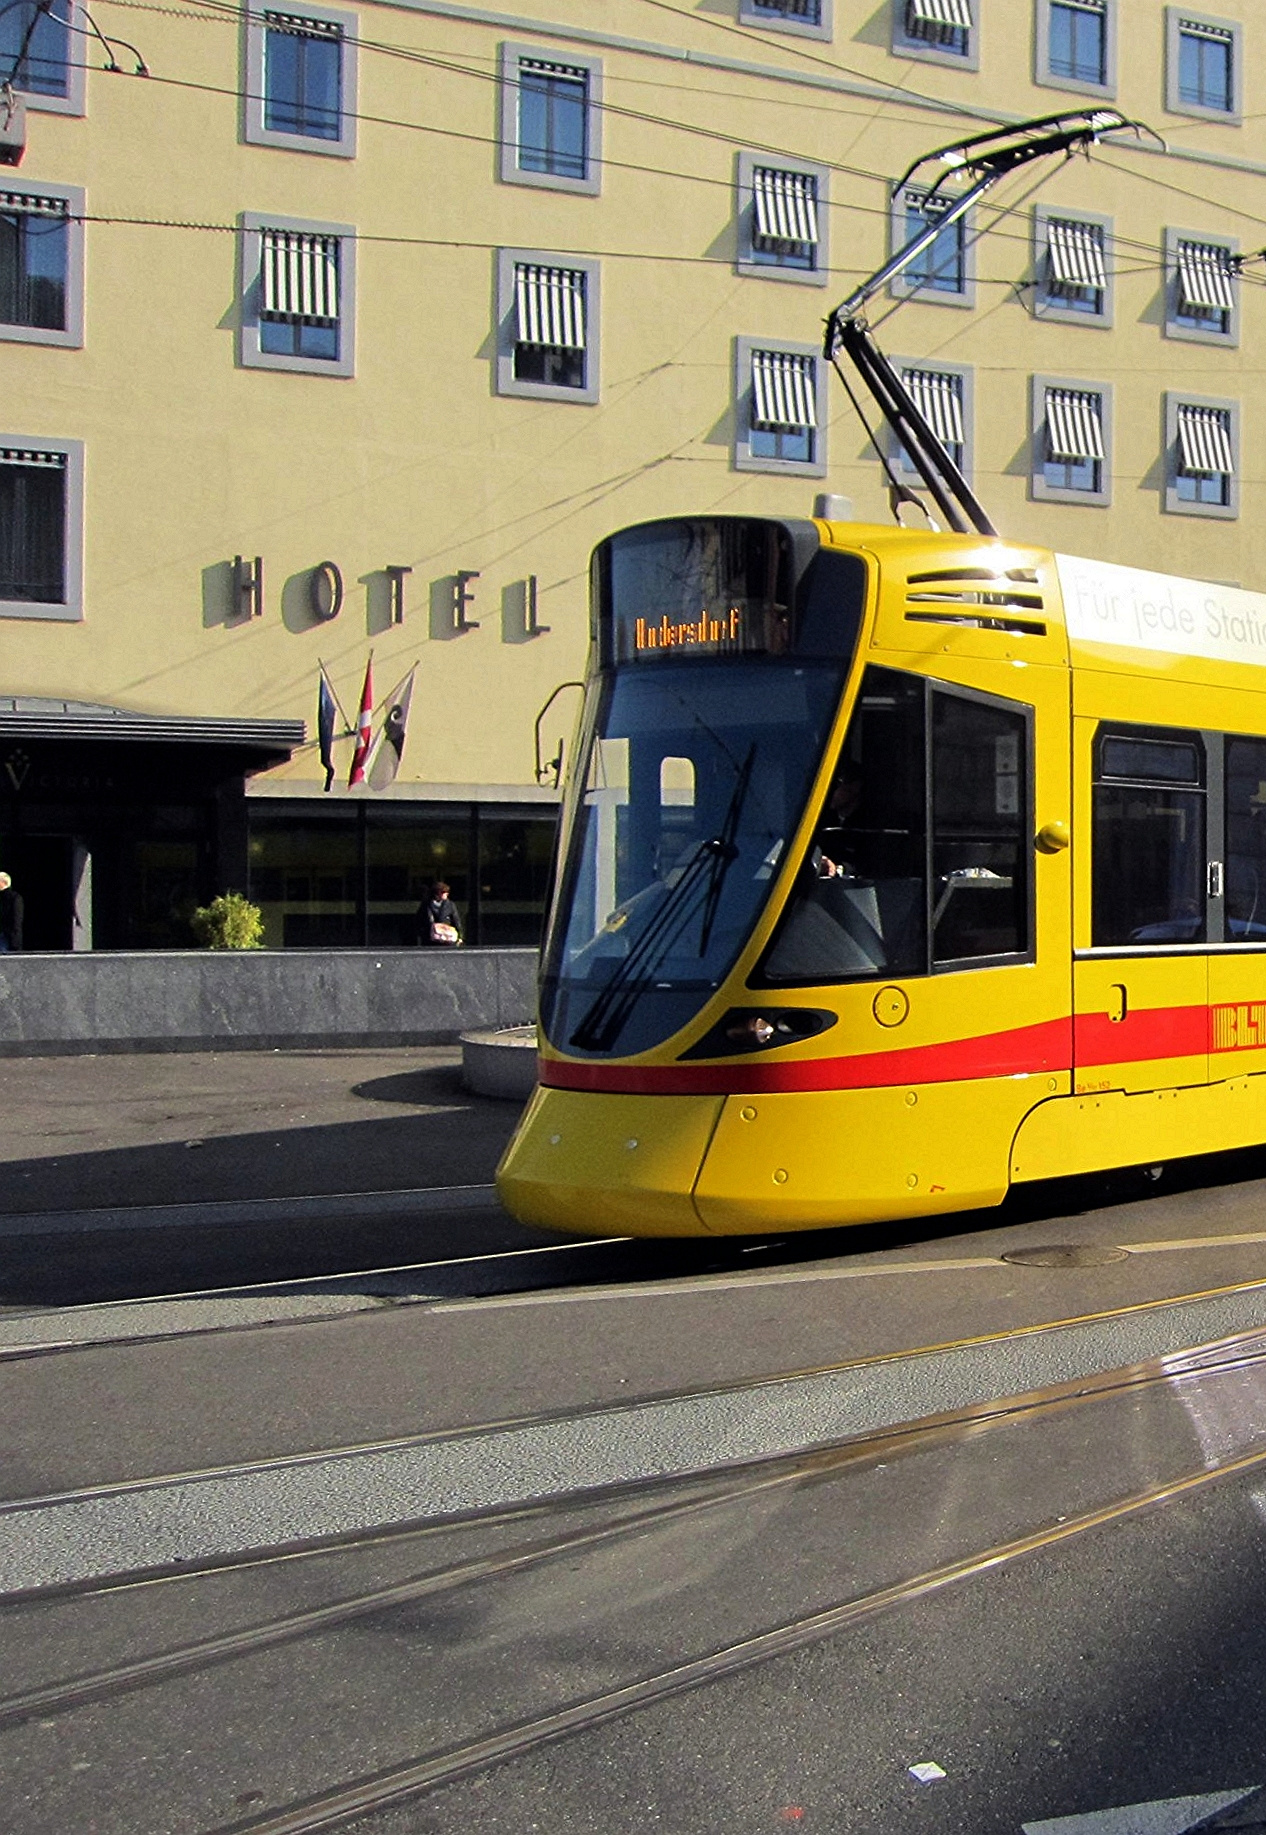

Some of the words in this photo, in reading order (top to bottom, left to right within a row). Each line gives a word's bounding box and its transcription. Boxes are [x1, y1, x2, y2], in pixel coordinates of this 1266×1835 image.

[233, 554, 549, 636] HOTEL
[1074, 575, 1117, 621] Für
[1130, 588, 1195, 640] jede
